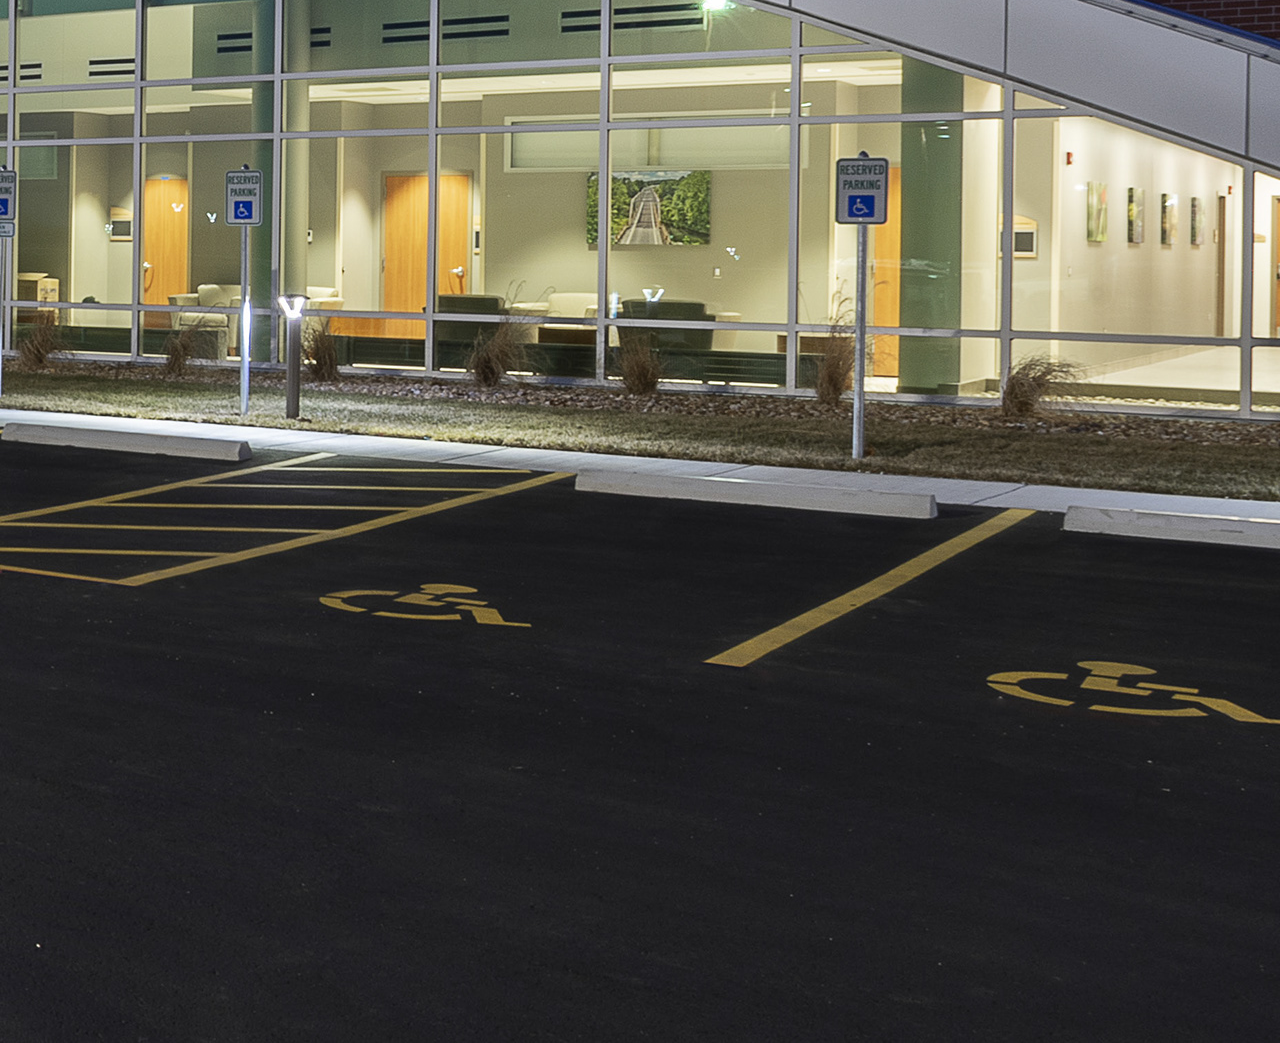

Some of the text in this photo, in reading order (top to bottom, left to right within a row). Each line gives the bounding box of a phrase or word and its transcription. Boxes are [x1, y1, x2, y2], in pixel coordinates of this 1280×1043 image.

[840, 165, 885, 175] RESERVED
[228, 175, 259, 184] RESERVED
[843, 180, 881, 190] PARKING
[230, 188, 257, 197] PARKING
